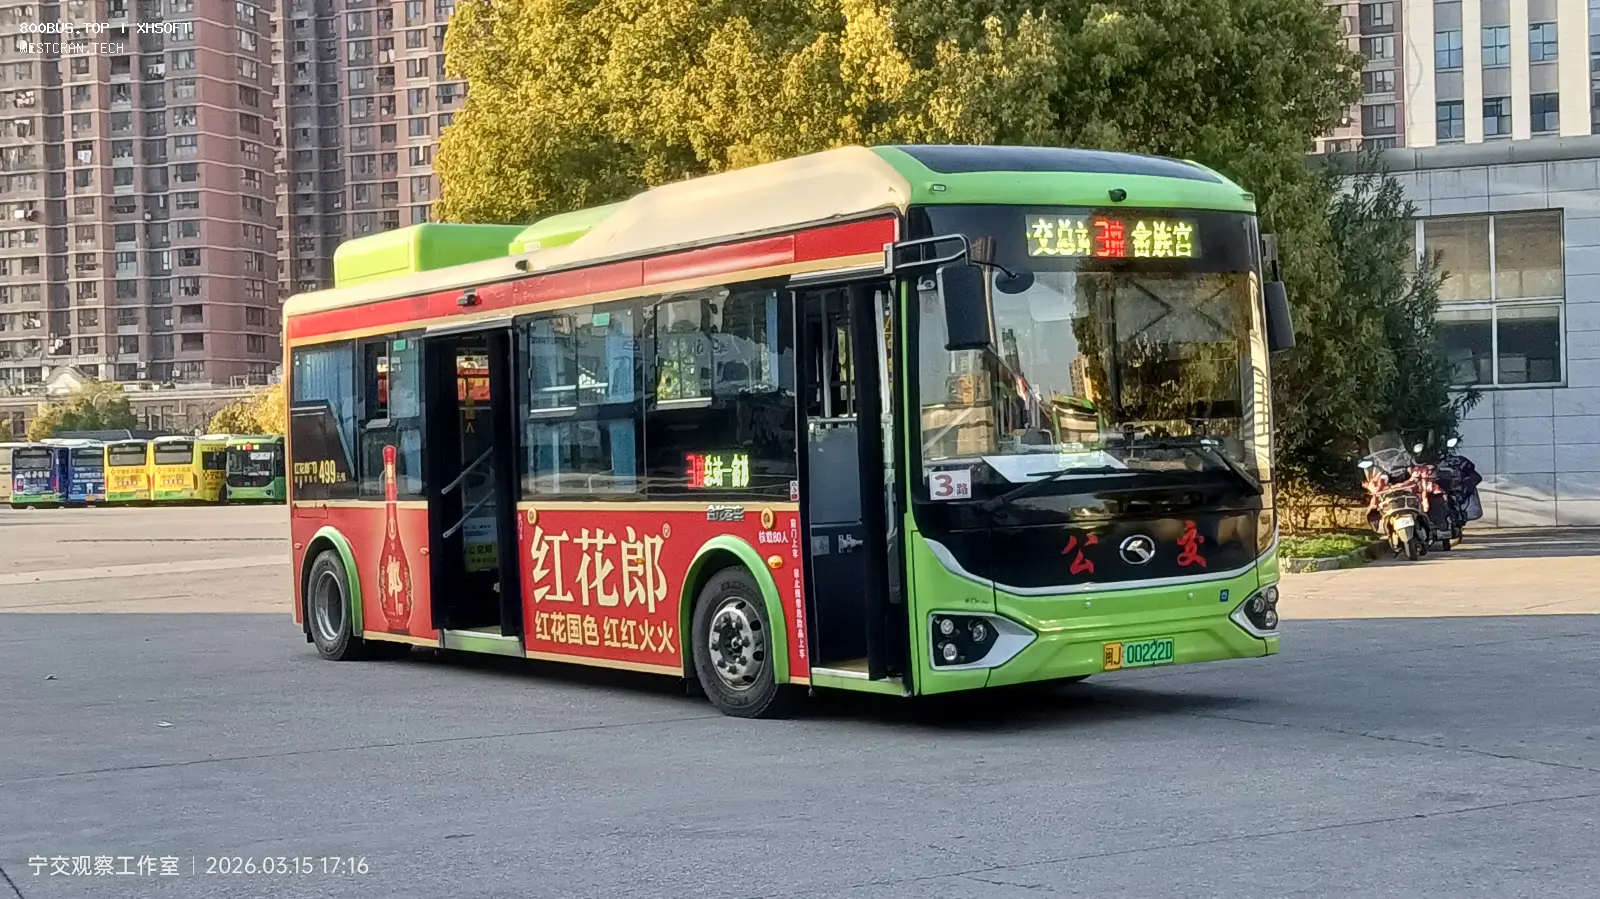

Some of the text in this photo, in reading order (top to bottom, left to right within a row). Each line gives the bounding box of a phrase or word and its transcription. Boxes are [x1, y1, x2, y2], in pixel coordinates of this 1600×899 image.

[318, 459, 336, 484] 499
[531, 525, 668, 613] 红花郎
[1061, 520, 1207, 575] 公 交
[534, 610, 676, 654] 红花国色 红红火火
